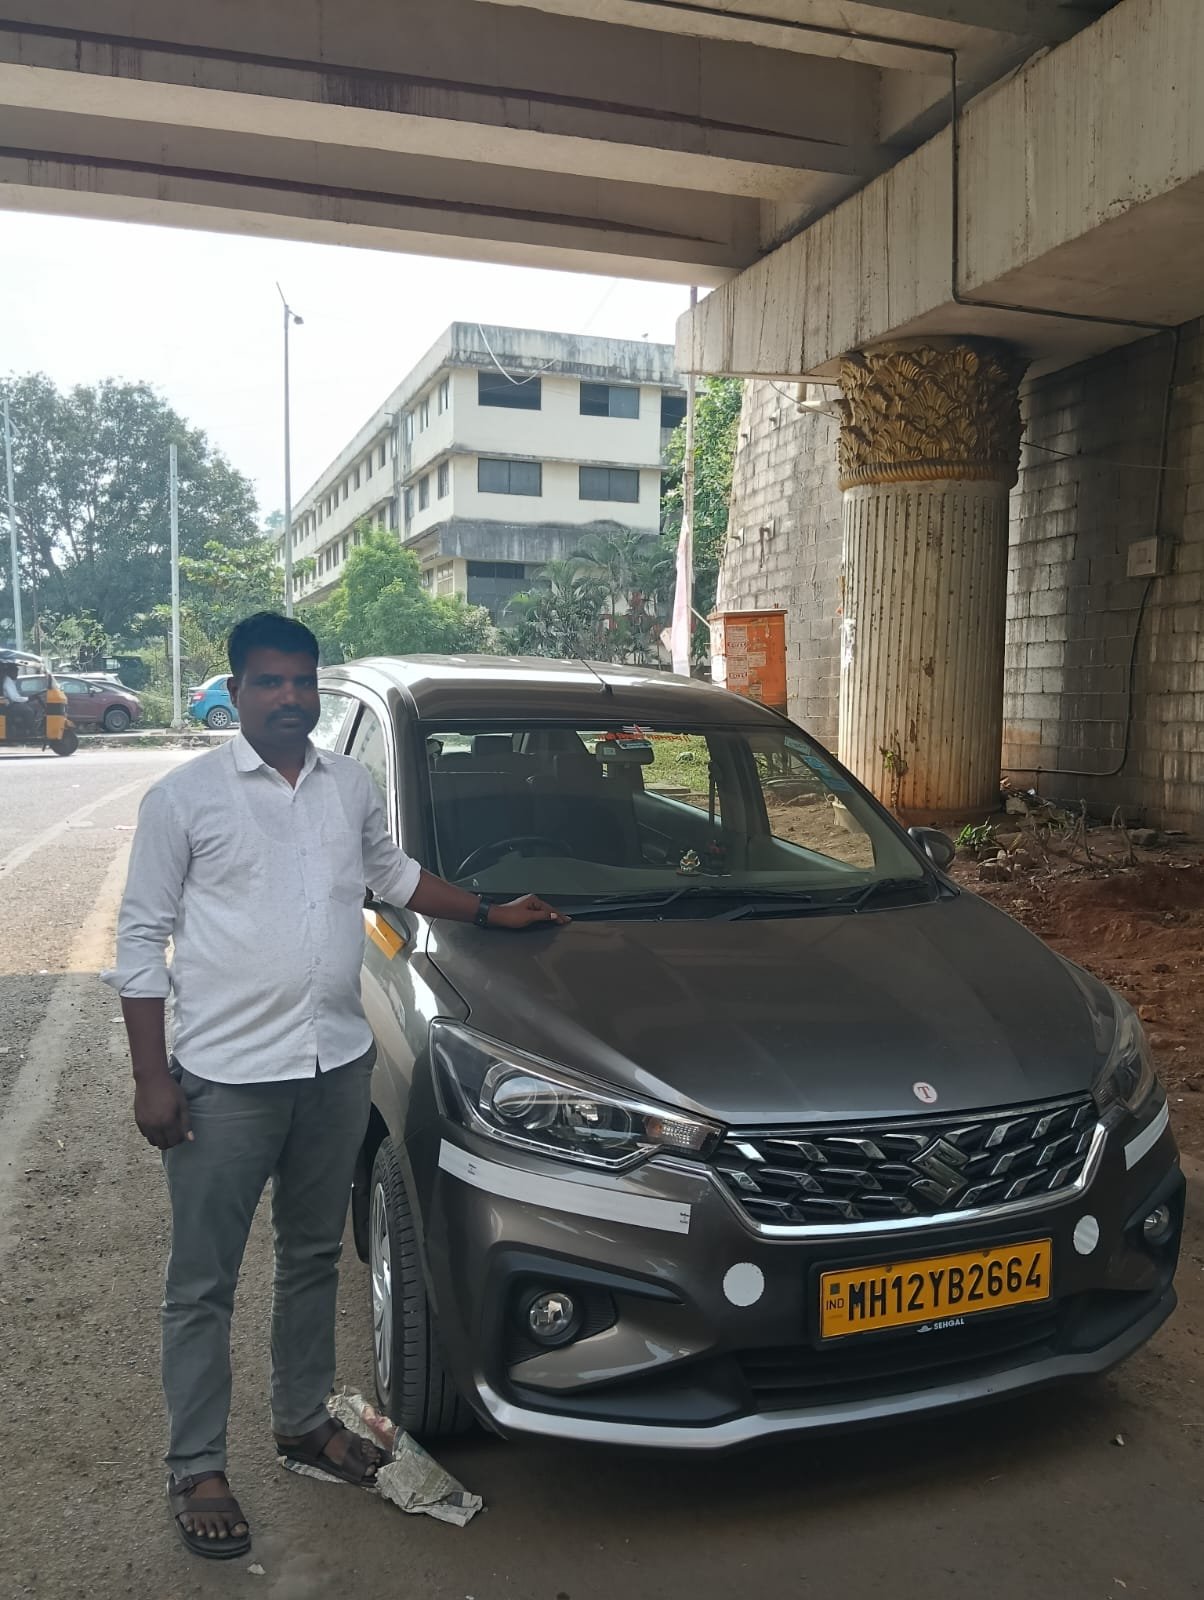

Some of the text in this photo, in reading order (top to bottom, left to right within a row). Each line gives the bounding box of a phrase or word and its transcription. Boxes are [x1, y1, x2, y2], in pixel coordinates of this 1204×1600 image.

[917, 1085, 932, 1098] T
[826, 1252, 1042, 1321] IND MH12YB2664
[933, 1317, 965, 1331] SEHGAL
